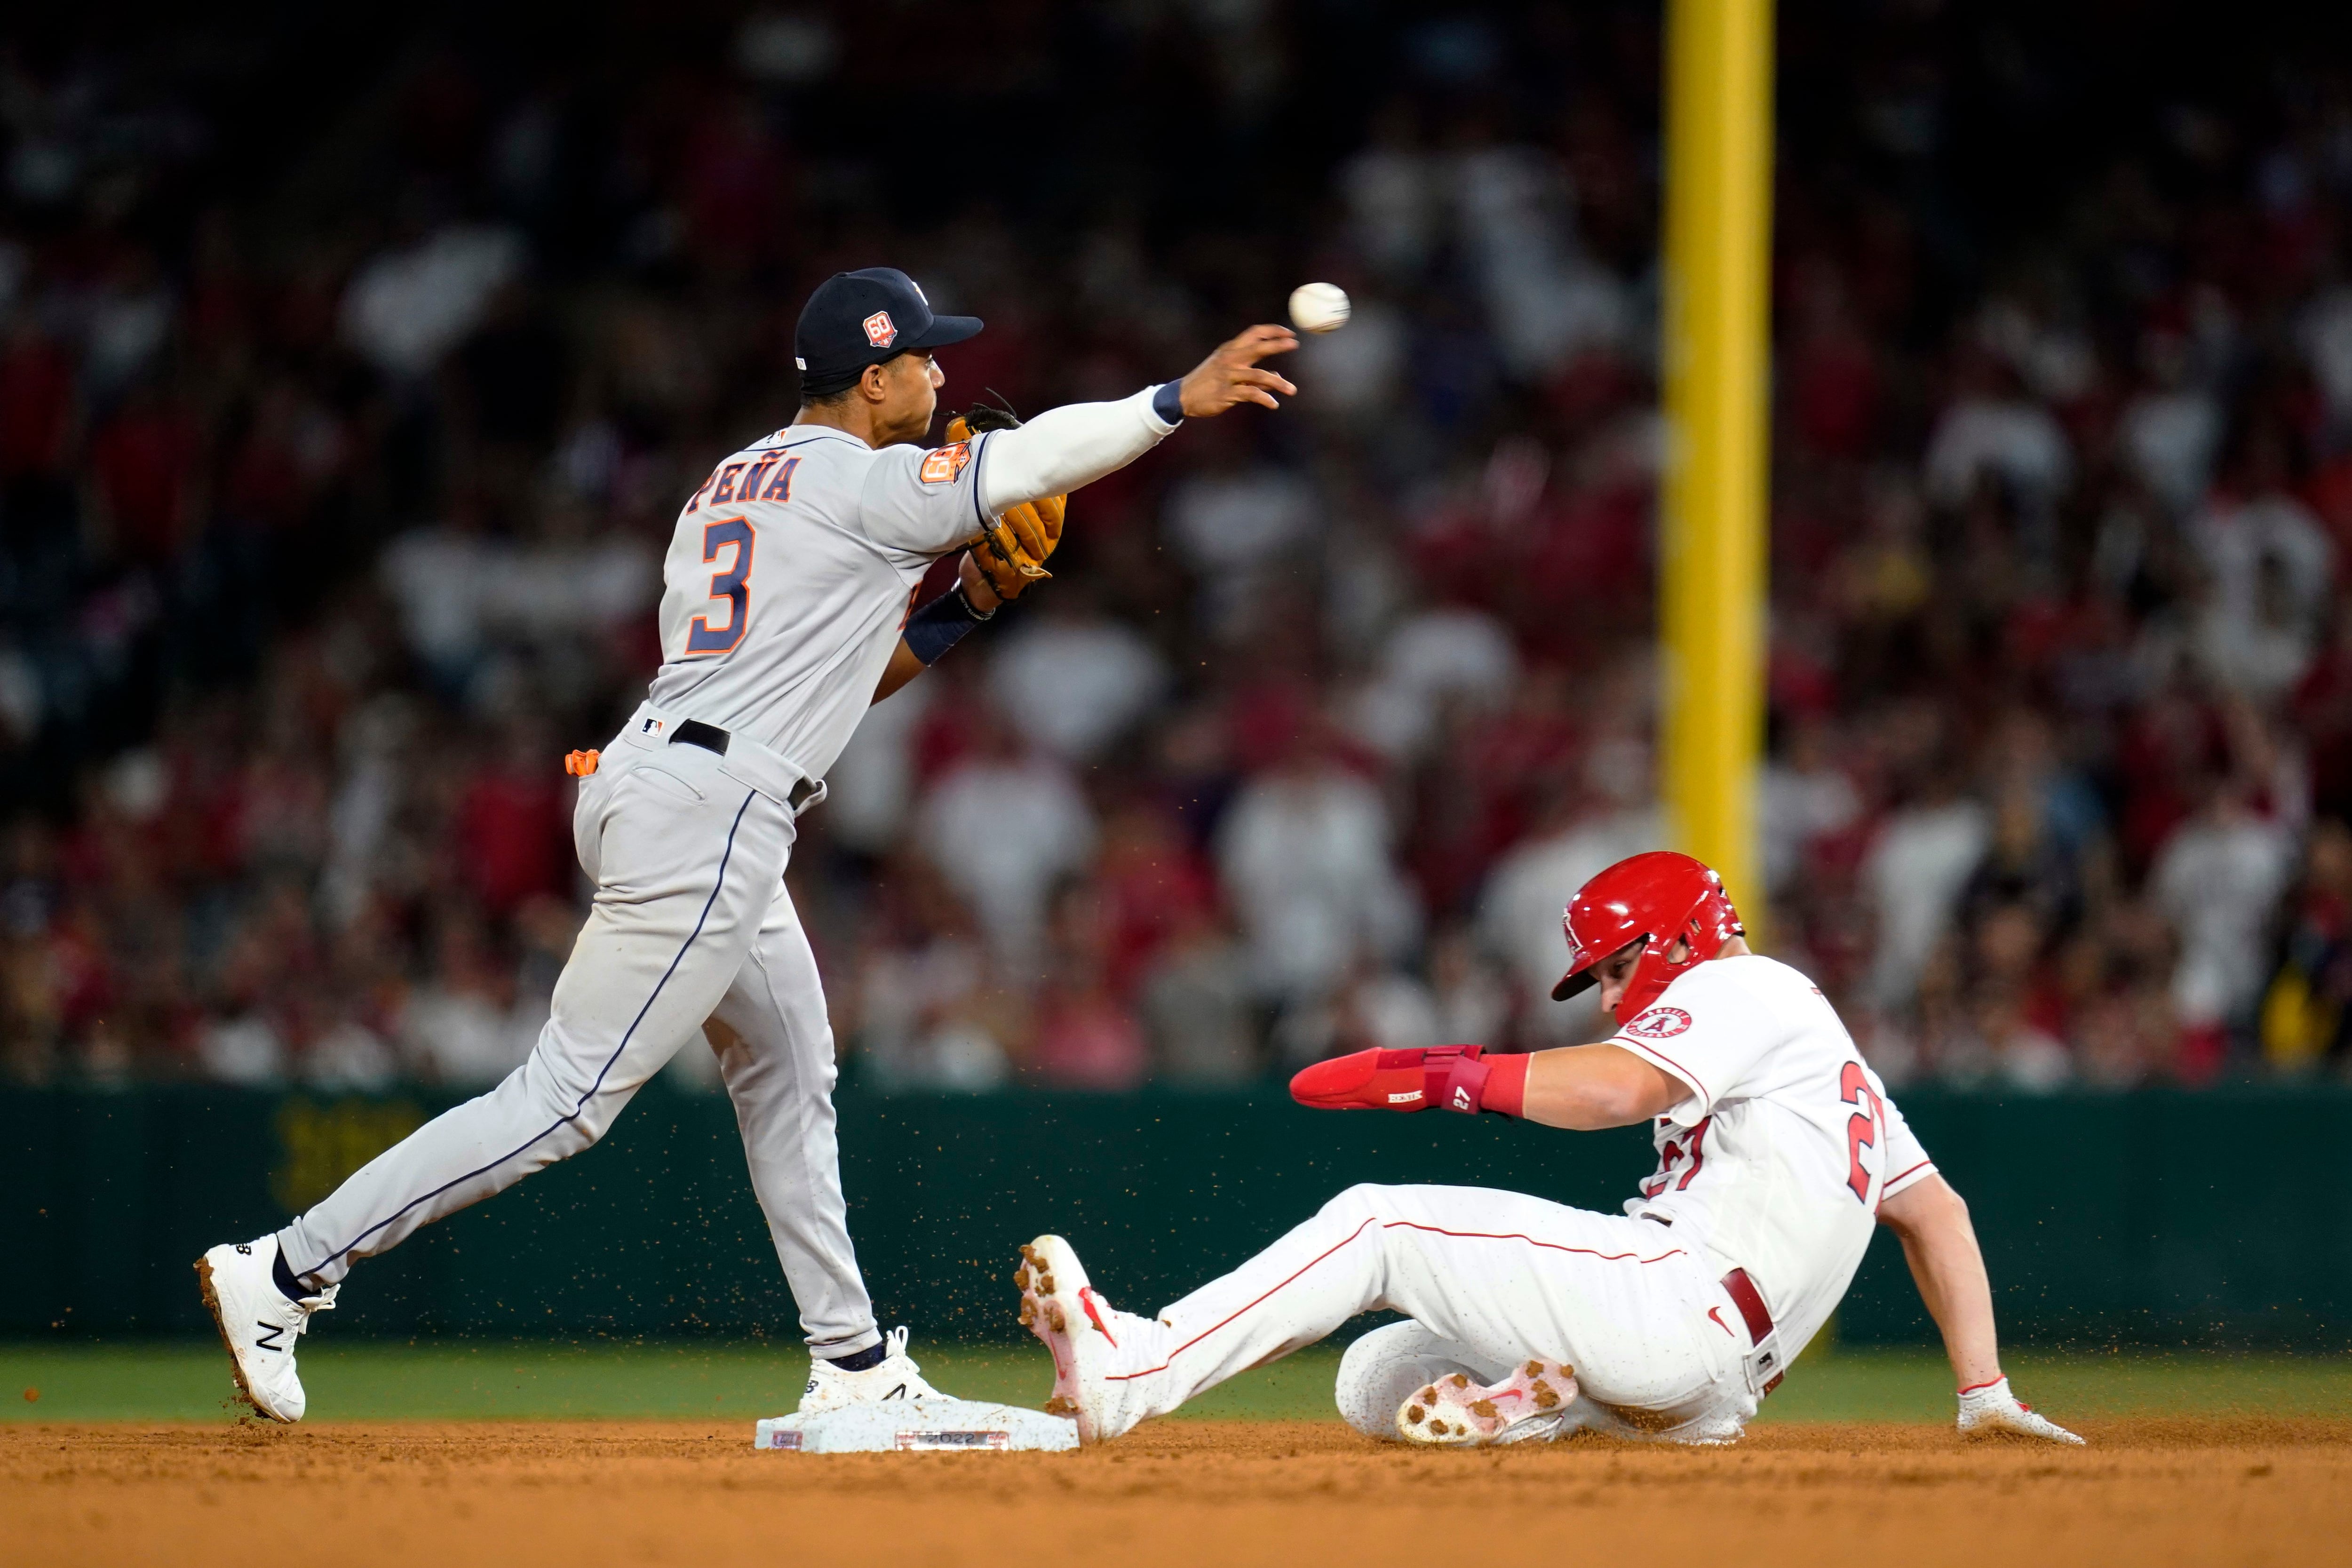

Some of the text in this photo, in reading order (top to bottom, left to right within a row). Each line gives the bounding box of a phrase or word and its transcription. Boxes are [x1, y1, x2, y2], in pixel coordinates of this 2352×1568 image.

[867, 315, 890, 339] 60
[925, 446, 957, 478] 60
[686, 450, 802, 516] PEÑA
[685, 515, 756, 655] 3
[1453, 1085, 1471, 1111] 27
[256, 1321, 284, 1352] N
[928, 1433, 975, 1444] 2022
